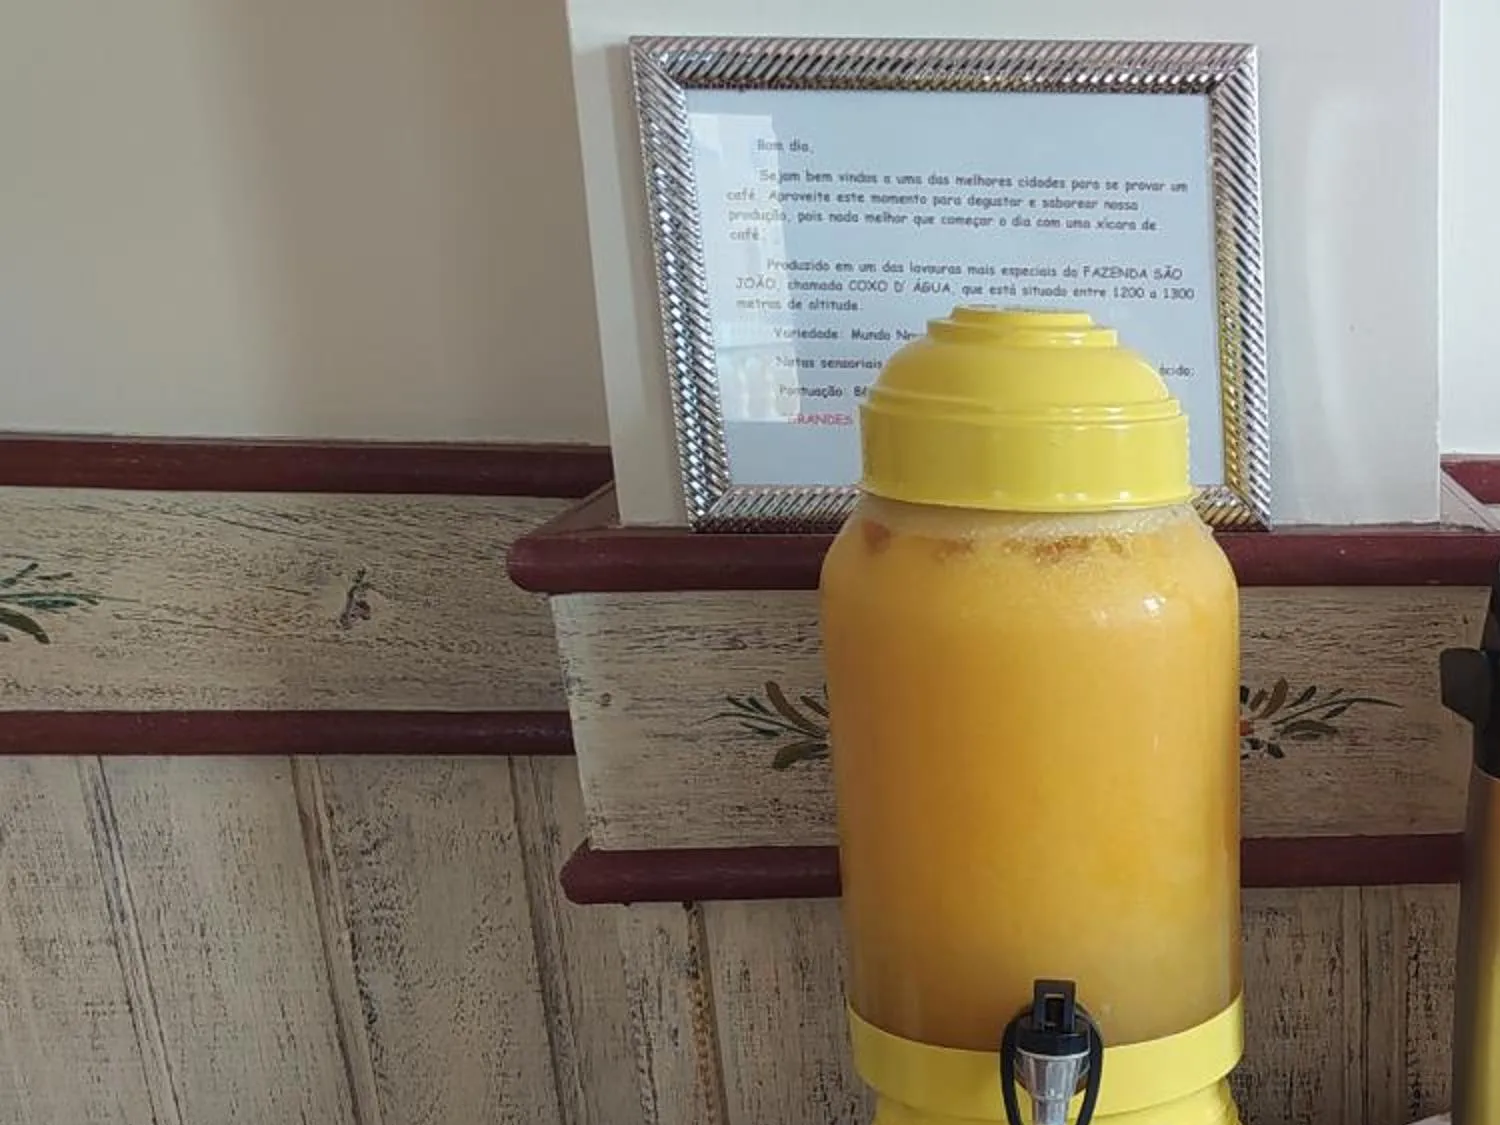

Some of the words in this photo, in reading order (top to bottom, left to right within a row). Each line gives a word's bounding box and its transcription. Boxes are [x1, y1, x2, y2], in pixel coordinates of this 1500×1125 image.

[805, 169, 832, 182] bem
[928, 171, 949, 185] das
[955, 174, 1012, 188] melhores
[1018, 175, 1065, 189] cidades
[1071, 178, 1099, 192] para
[1105, 179, 1119, 190] se
[1125, 180, 1165, 193] provar
[1170, 181, 1188, 193] um
[769, 189, 830, 204] Aproveite
[836, 191, 865, 203] este
[871, 192, 927, 205] momento
[932, 194, 961, 208] para
[967, 194, 1023, 211] degustar
[1029, 198, 1036, 208] e
[1042, 196, 1098, 210] saborear
[1104, 199, 1139, 211] nossa
[797, 209, 823, 224] pois
[829, 210, 859, 223] nada
[865, 210, 908, 224] melhor
[913, 214, 934, 228] que
[941, 215, 993, 230] começar
[1012, 214, 1031, 227] dia
[1066, 218, 1091, 229] uma
[1141, 218, 1157, 231] de
[767, 259, 830, 272] Produzido
[835, 261, 854, 272] em
[881, 259, 904, 273] das
[909, 260, 962, 275] lavouras
[968, 264, 995, 276] mais
[1001, 265, 1056, 279] especiais
[1083, 264, 1147, 280] FAZENDA
[1153, 263, 1183, 280] SÃO
[847, 279, 888, 293] COXO
[962, 284, 983, 297] que
[1073, 286, 1106, 298] entre
[1113, 287, 1144, 299] 1200
[1163, 287, 1195, 299] 1300
[787, 298, 802, 311] de
[851, 327, 891, 341] Mundo
